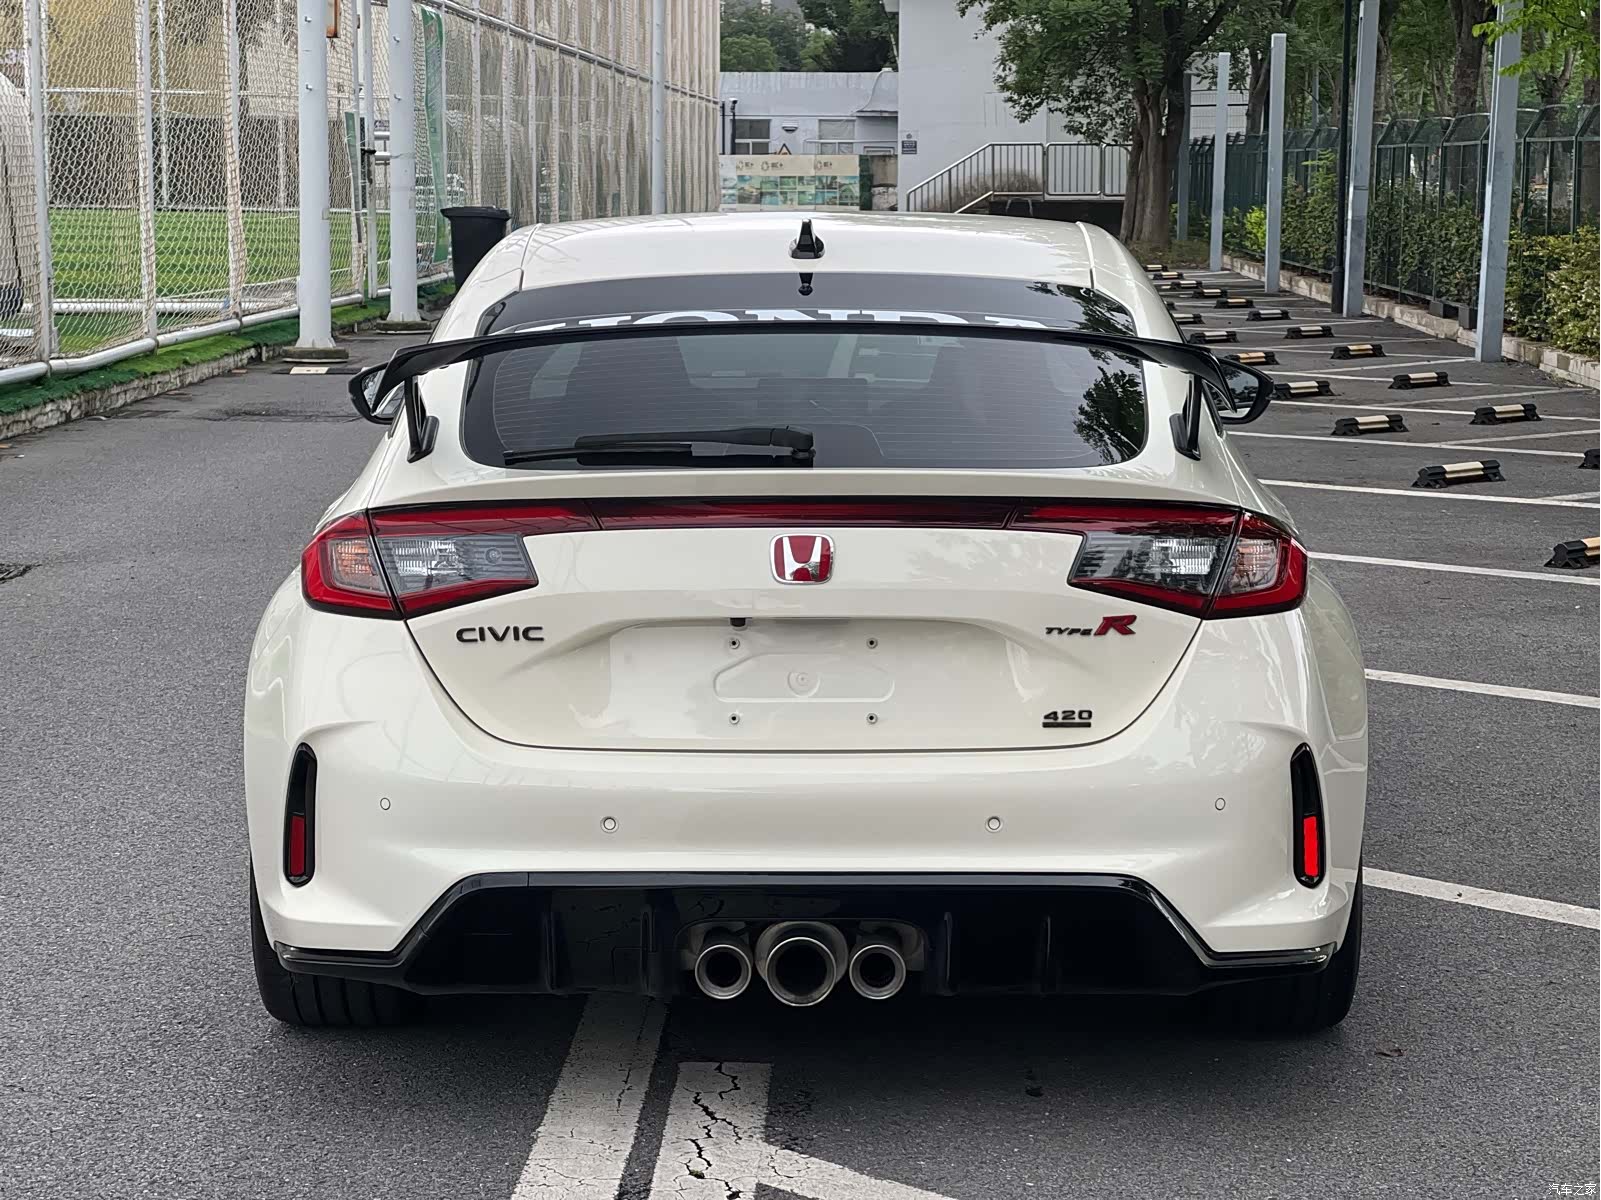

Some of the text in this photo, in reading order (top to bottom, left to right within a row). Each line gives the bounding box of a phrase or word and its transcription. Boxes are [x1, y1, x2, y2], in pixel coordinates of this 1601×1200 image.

[455, 625, 545, 643] CIVIC
[1045, 614, 1137, 637] TYPE R
[1043, 709, 1092, 721] 420
